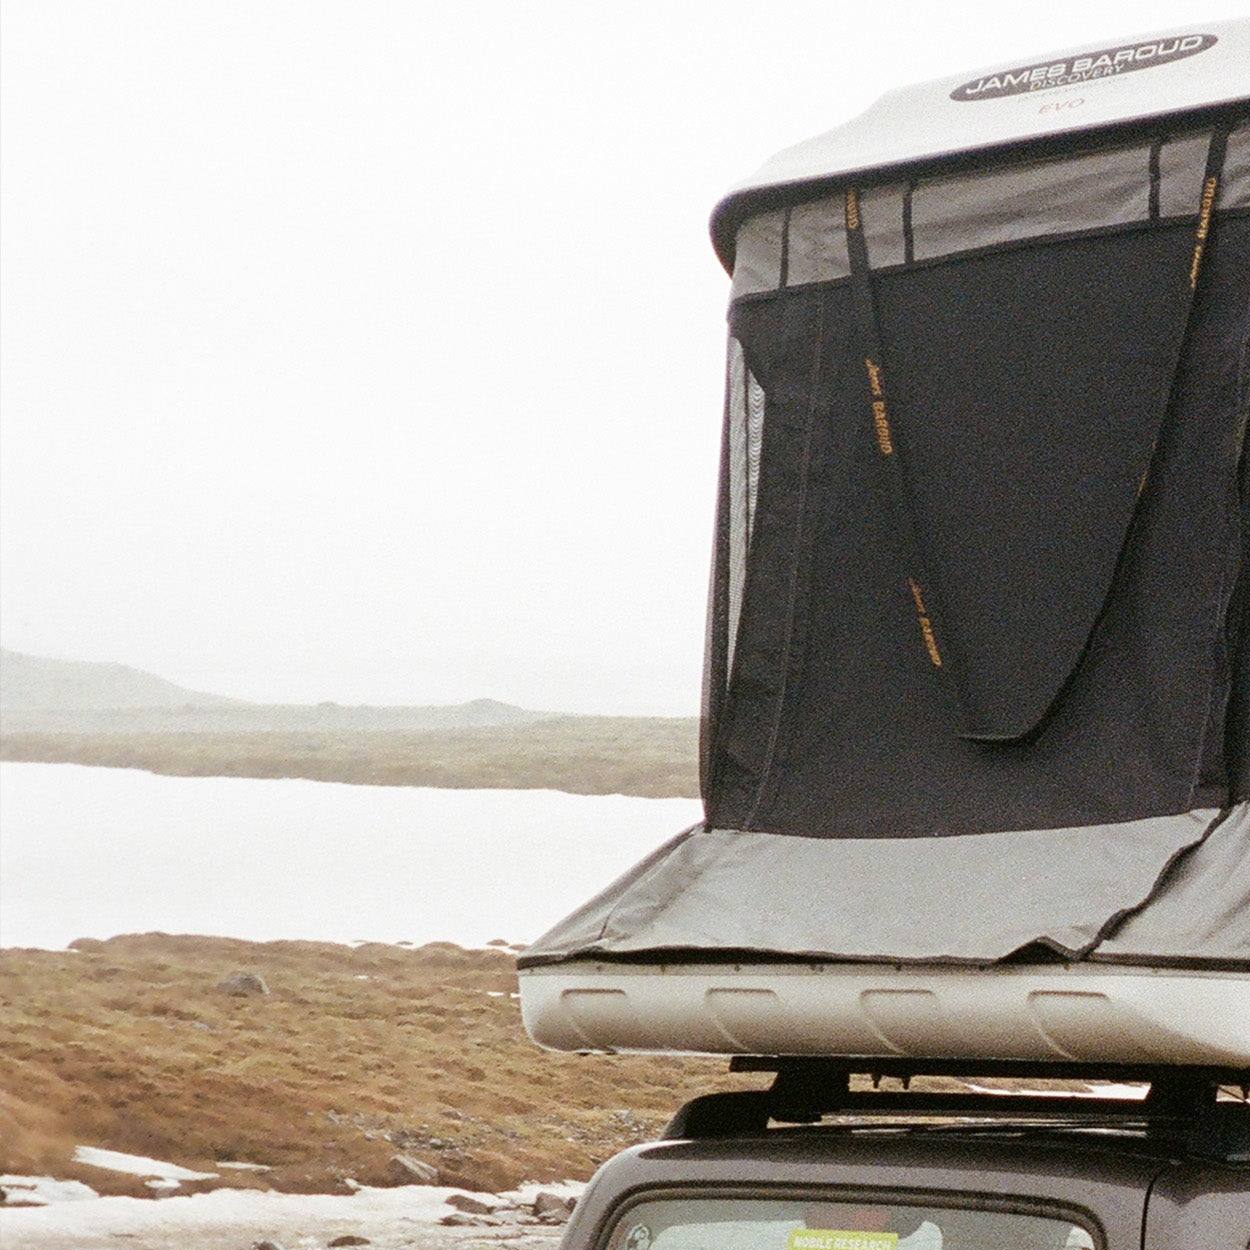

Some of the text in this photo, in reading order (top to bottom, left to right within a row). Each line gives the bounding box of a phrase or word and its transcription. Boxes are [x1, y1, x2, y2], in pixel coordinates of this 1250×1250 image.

[965, 35, 1203, 94] JAMES BAROUD
[1029, 62, 1126, 92] DISCOVERY
[872, 400, 893, 455] BAROUD
[794, 1236, 832, 1249] MOBILE
